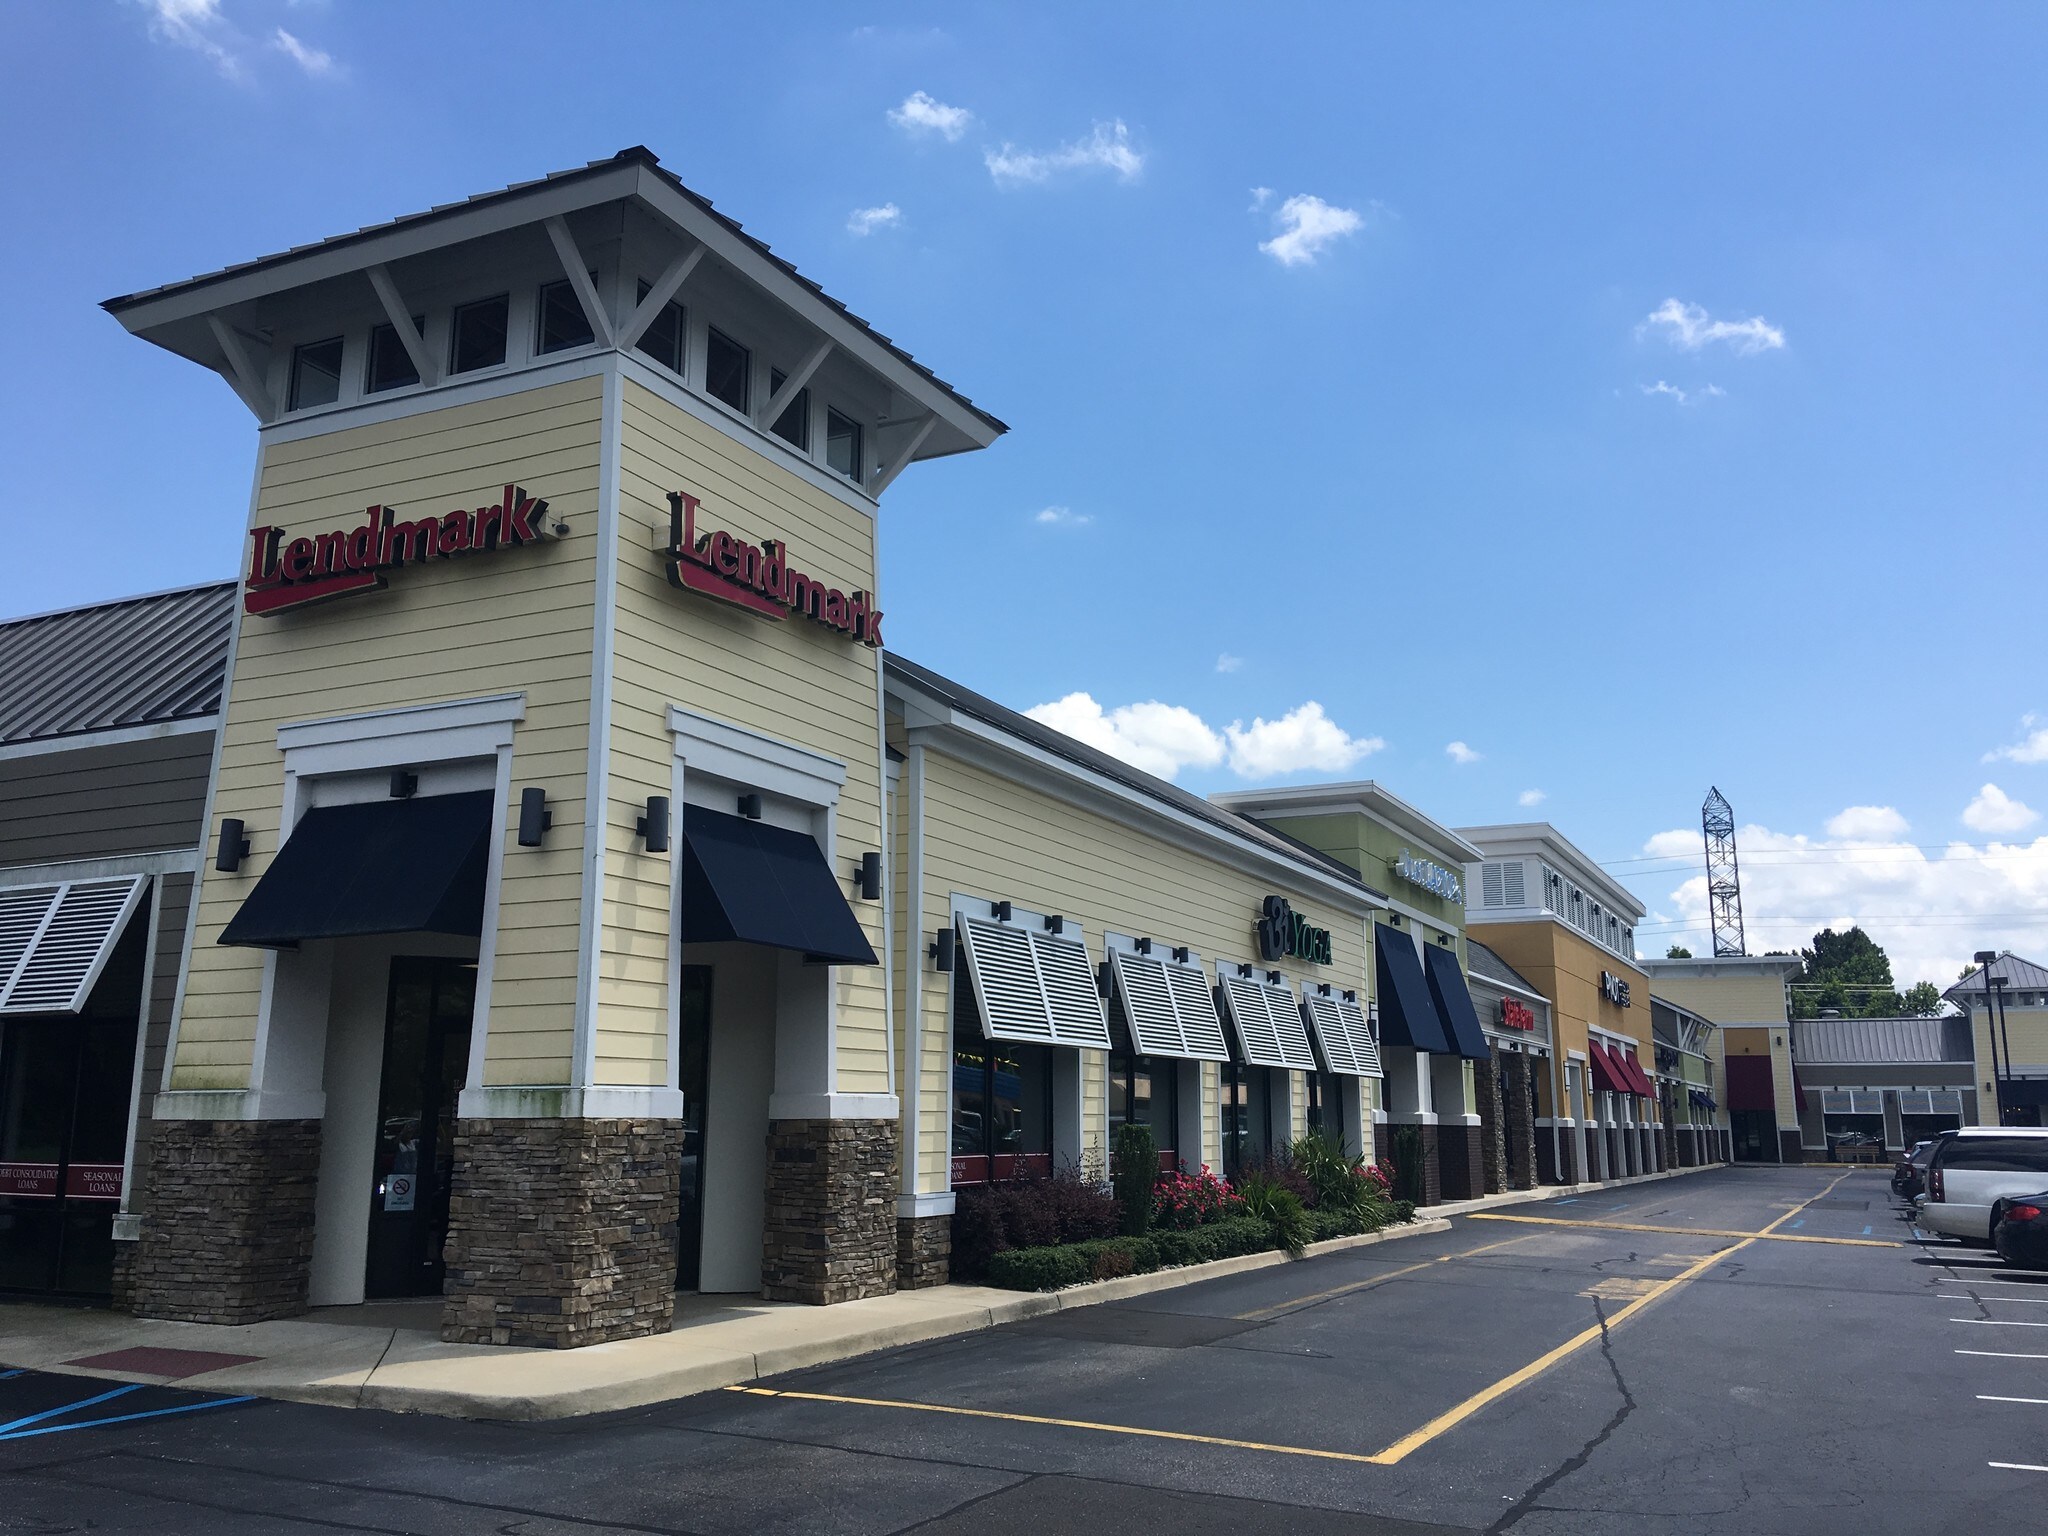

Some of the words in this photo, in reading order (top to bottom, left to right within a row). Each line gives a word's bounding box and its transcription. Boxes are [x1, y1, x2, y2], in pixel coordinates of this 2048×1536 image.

[245, 484, 546, 589] Lendmark
[670, 490, 885, 647] Lendmark
[1290, 909, 1333, 966] YOGA
[17, 1179, 38, 1189] LOANS
[83, 1171, 123, 1182] SEASONAL
[89, 1183, 116, 1193] LOANS
